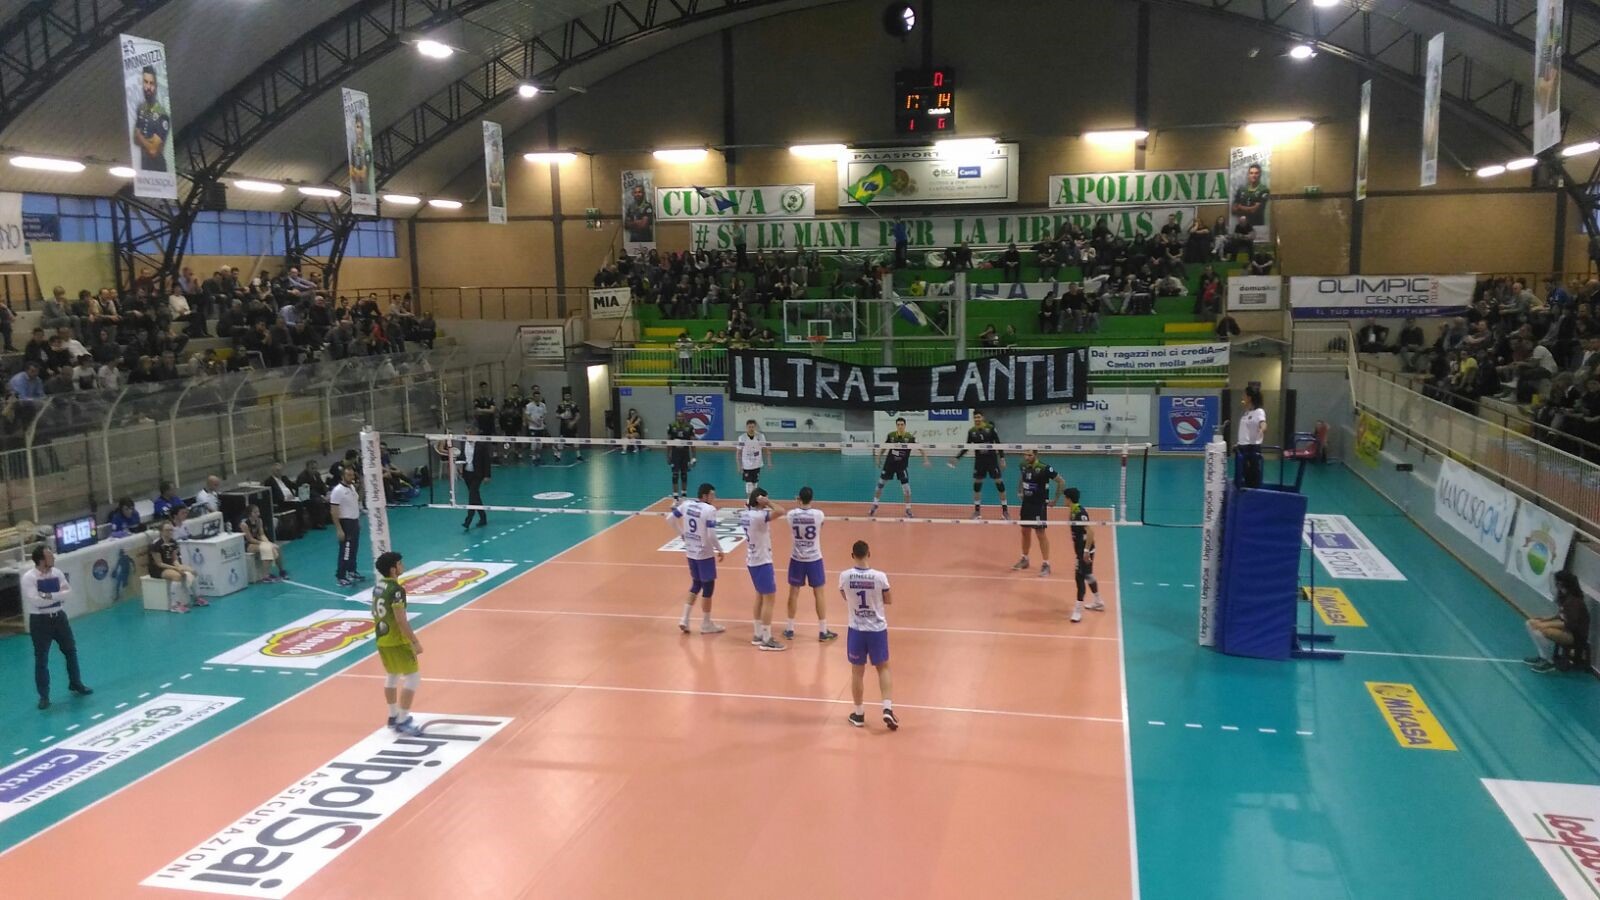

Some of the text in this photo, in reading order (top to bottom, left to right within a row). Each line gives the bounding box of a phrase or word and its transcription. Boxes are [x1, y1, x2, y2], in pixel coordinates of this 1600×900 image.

[938, 93, 951, 107] 14
[1056, 171, 1229, 203] APOLLONIA
[757, 223, 785, 247] LE
[794, 221, 860, 248] MANI
[953, 217, 987, 244] LA
[1318, 278, 1430, 294] OLIMPIC
[594, 296, 619, 309] MIA
[1366, 295, 1429, 304] CENTER
[1091, 350, 1108, 358] Dai
[1113, 350, 1149, 360] ragazzi
[1151, 349, 1167, 357] noi
[735, 355, 900, 402] ULTRAS
[685, 396, 712, 404] PGC
[1172, 398, 1205, 407] PGC
[689, 518, 697, 533] 9
[793, 526, 816, 540] 18
[856, 591, 870, 609] 1
[1383, 697, 1431, 746] MIKASA
[190, 719, 502, 889] UnipolSai
[156, 772, 329, 879] ASSICURAZIONI
